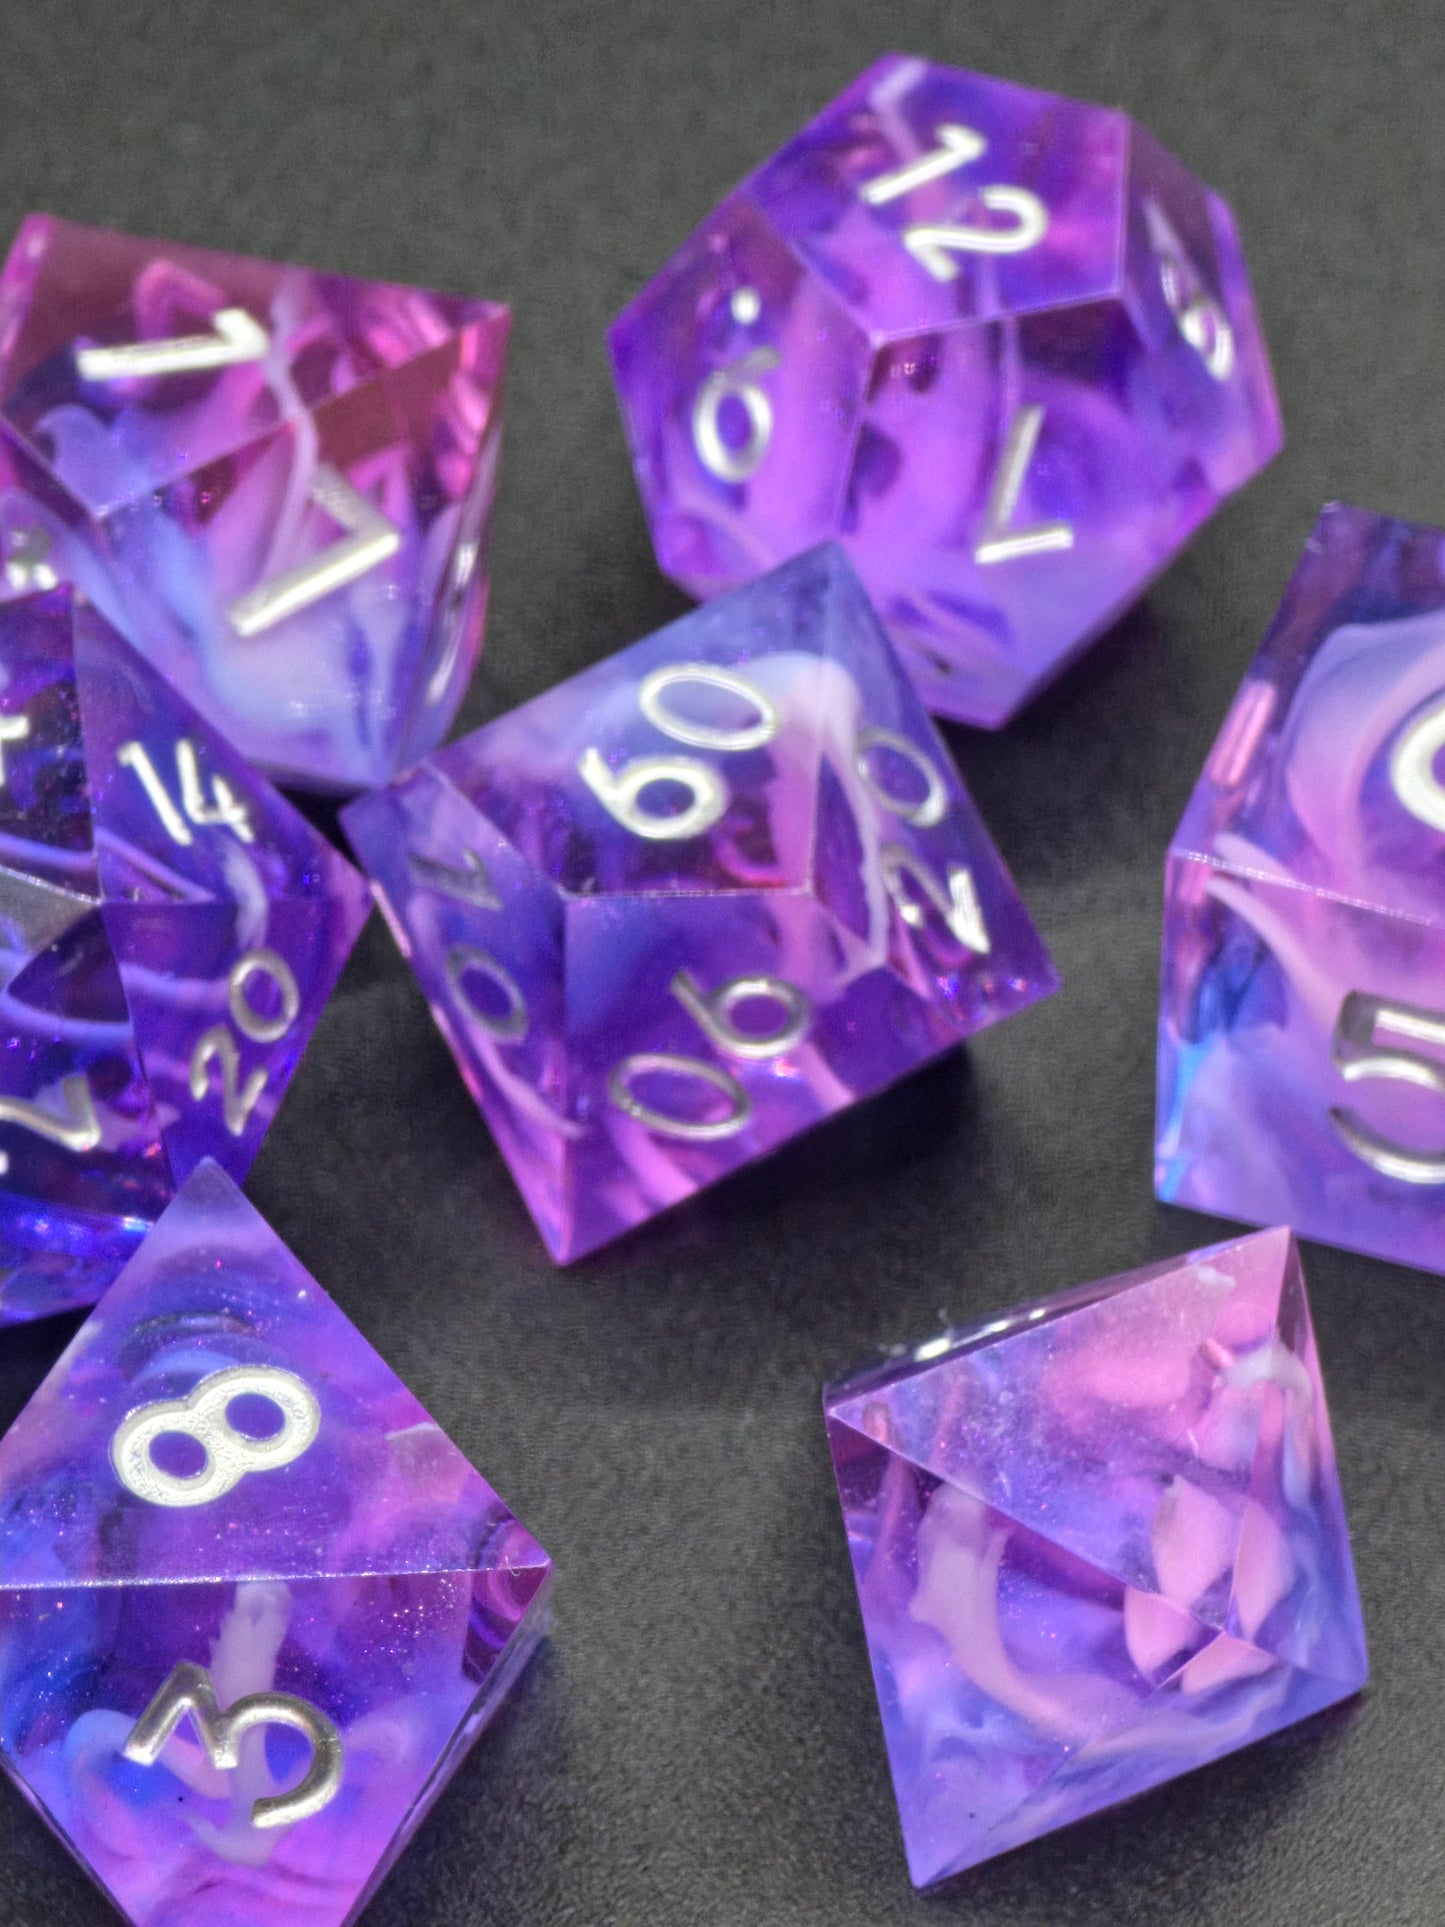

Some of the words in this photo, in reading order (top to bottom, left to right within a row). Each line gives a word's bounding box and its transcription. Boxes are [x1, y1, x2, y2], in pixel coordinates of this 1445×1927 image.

[859, 121, 1048, 281] 12
[76, 308, 269, 381] 1
[117, 739, 255, 846] 14
[578, 661, 780, 840] 60
[852, 727, 991, 955] 20
[189, 947, 300, 1138] 20
[110, 1364, 321, 1507] 8
[122, 1660, 344, 1829] 3
